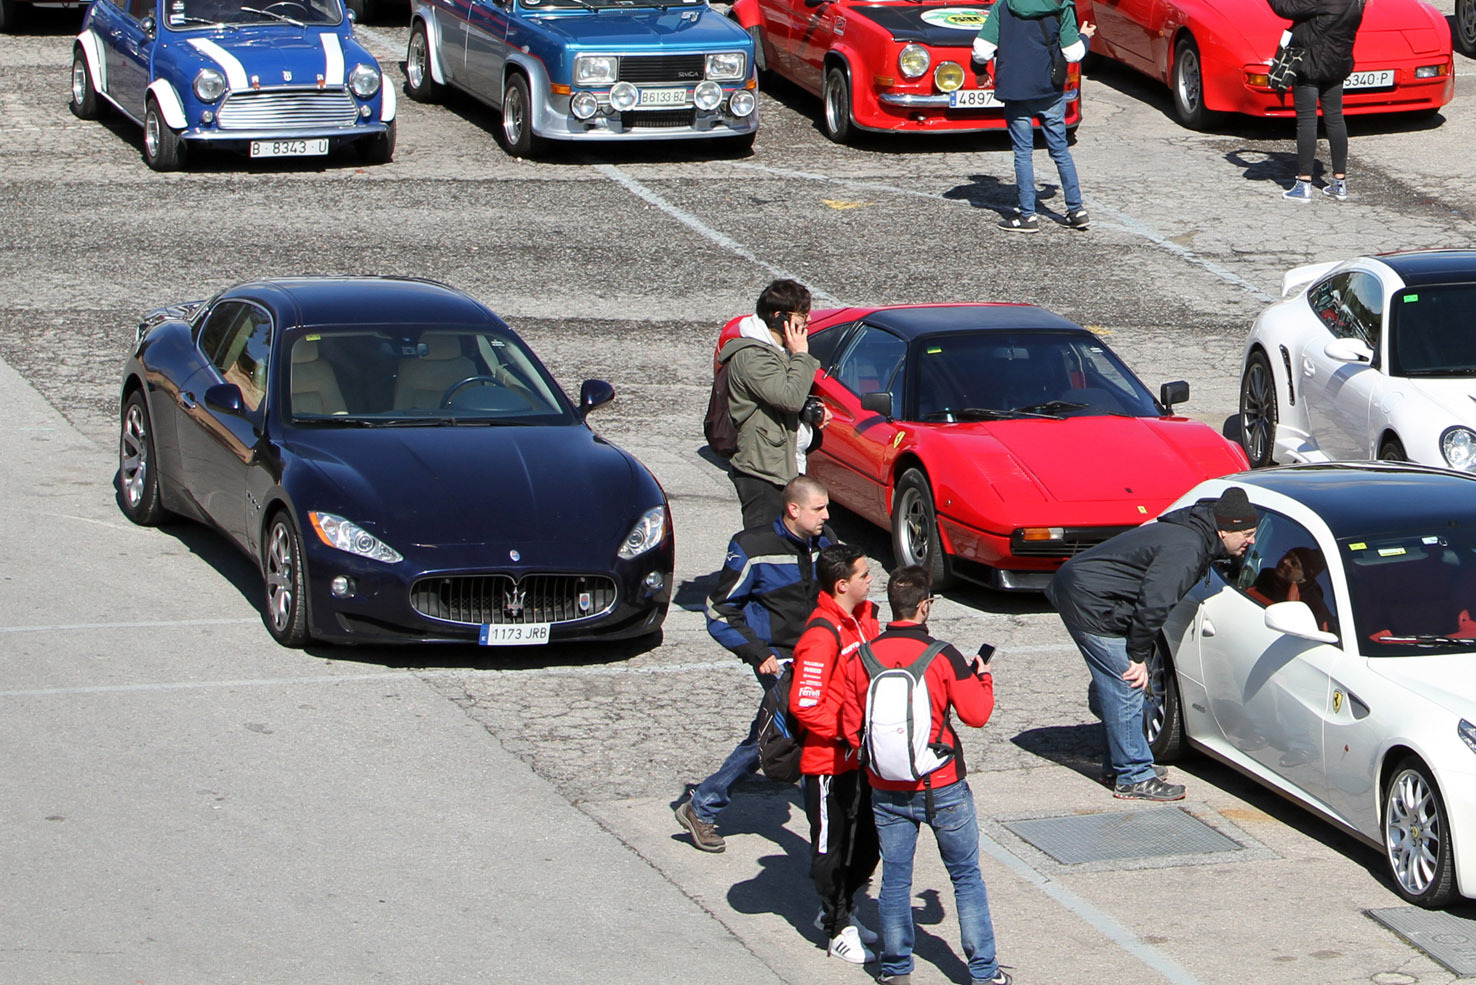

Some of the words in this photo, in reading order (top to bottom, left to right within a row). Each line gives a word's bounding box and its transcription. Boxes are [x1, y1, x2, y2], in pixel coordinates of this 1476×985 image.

[649, 92, 671, 103] 6133
[959, 92, 995, 105] 4897
[272, 141, 307, 154] 8343
[318, 140, 327, 153] U
[492, 628, 522, 640] 1173
[525, 627, 548, 640] JRB
